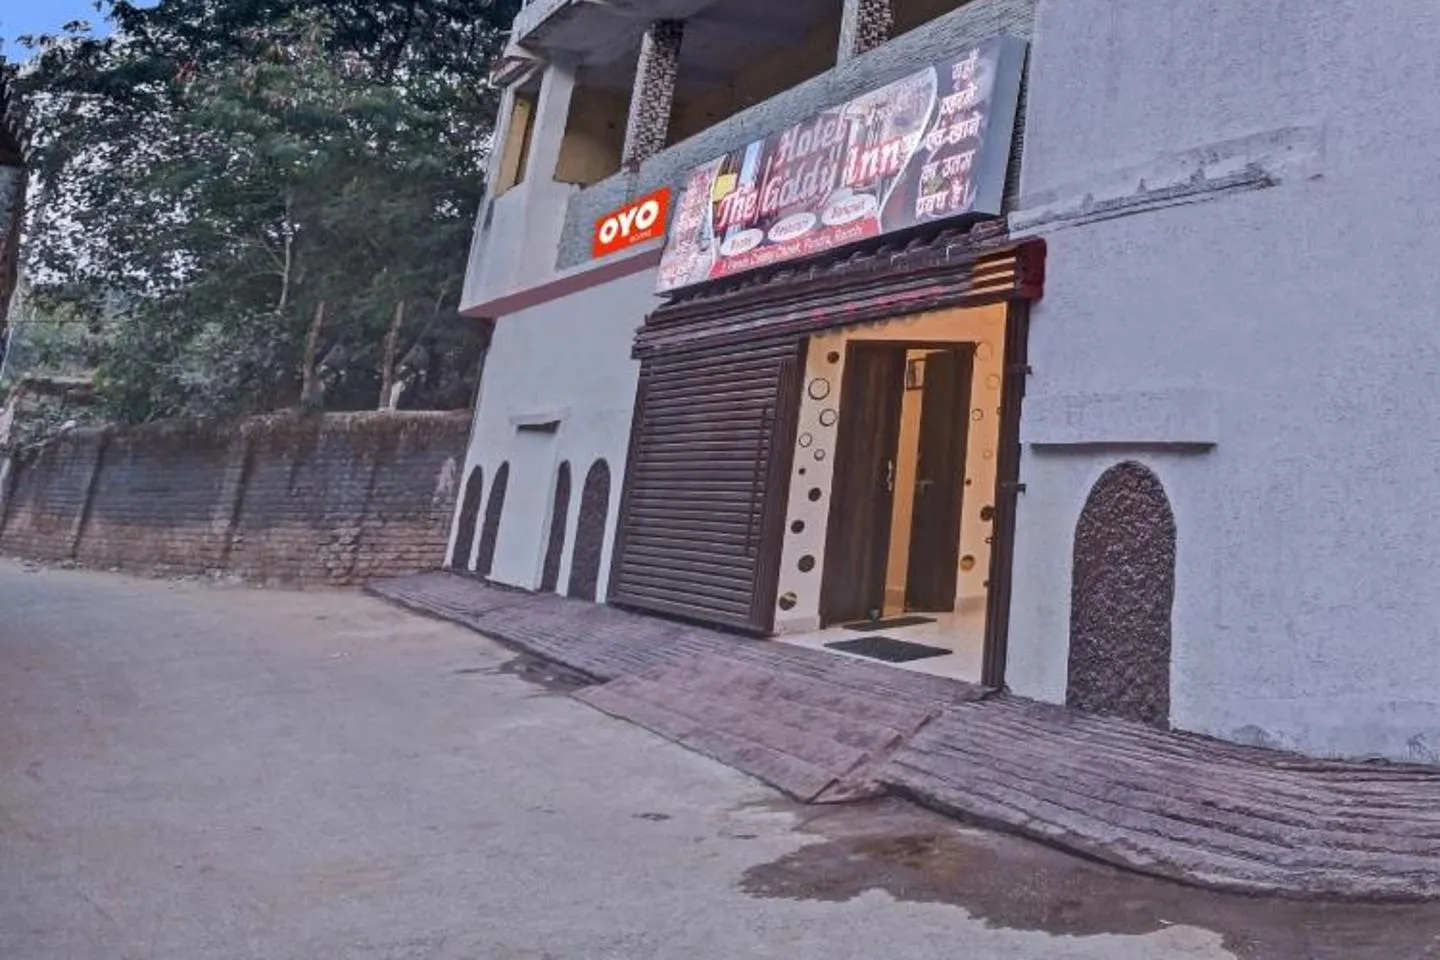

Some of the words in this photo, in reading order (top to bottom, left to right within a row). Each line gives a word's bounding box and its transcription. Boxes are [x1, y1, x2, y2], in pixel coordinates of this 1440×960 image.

[771, 102, 851, 167] Hotel
[719, 187, 758, 228] The
[762, 144, 843, 212] Goldy
[842, 138, 902, 187] Inn
[599, 200, 659, 244] OYO
